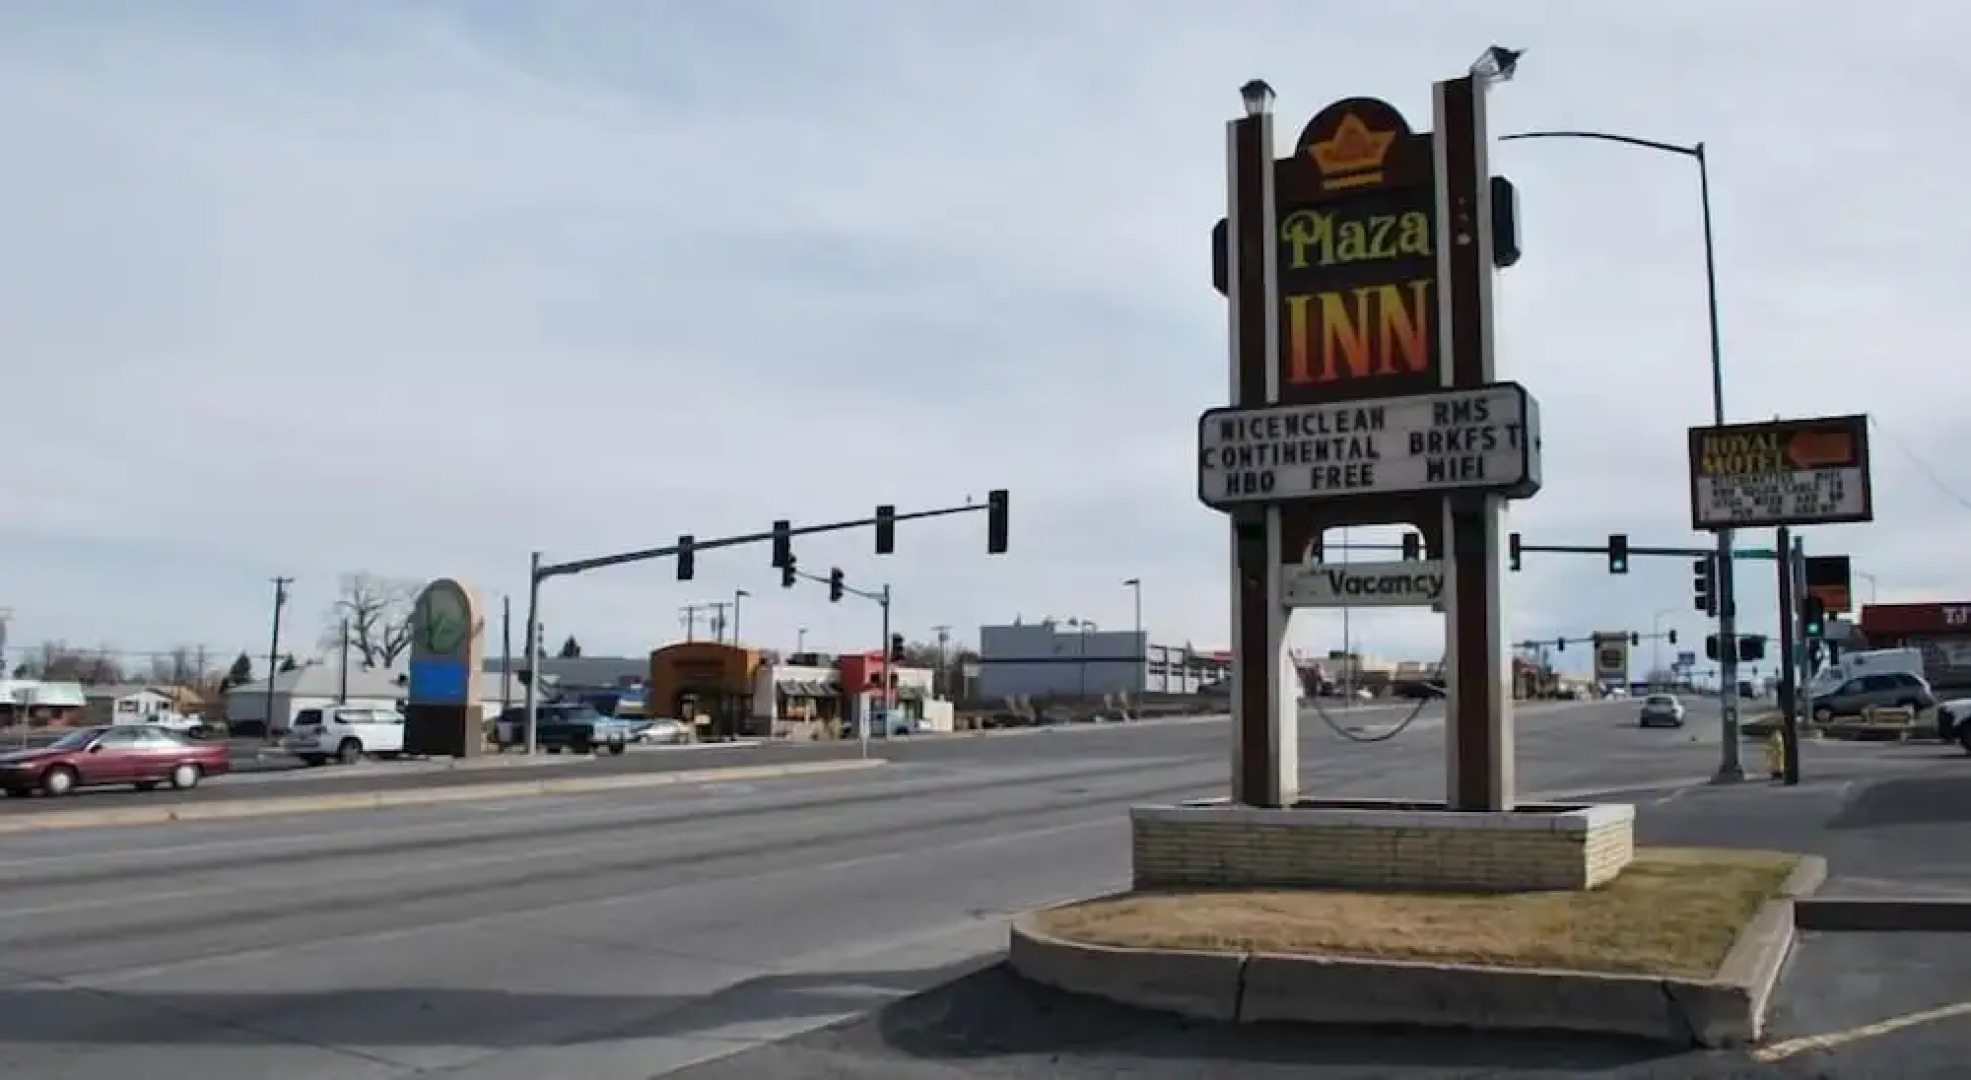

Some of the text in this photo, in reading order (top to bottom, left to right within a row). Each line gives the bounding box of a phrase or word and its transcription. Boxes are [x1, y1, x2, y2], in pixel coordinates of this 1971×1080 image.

[1282, 208, 1435, 268] Plaza
[1285, 277, 1435, 384] INN
[1433, 398, 1490, 426] RMS
[1201, 434, 1381, 469] CONTINENTAL
[1226, 469, 1276, 496] HBO
[1311, 462, 1375, 490] FREE
[1329, 569, 1444, 599] Vacancy
